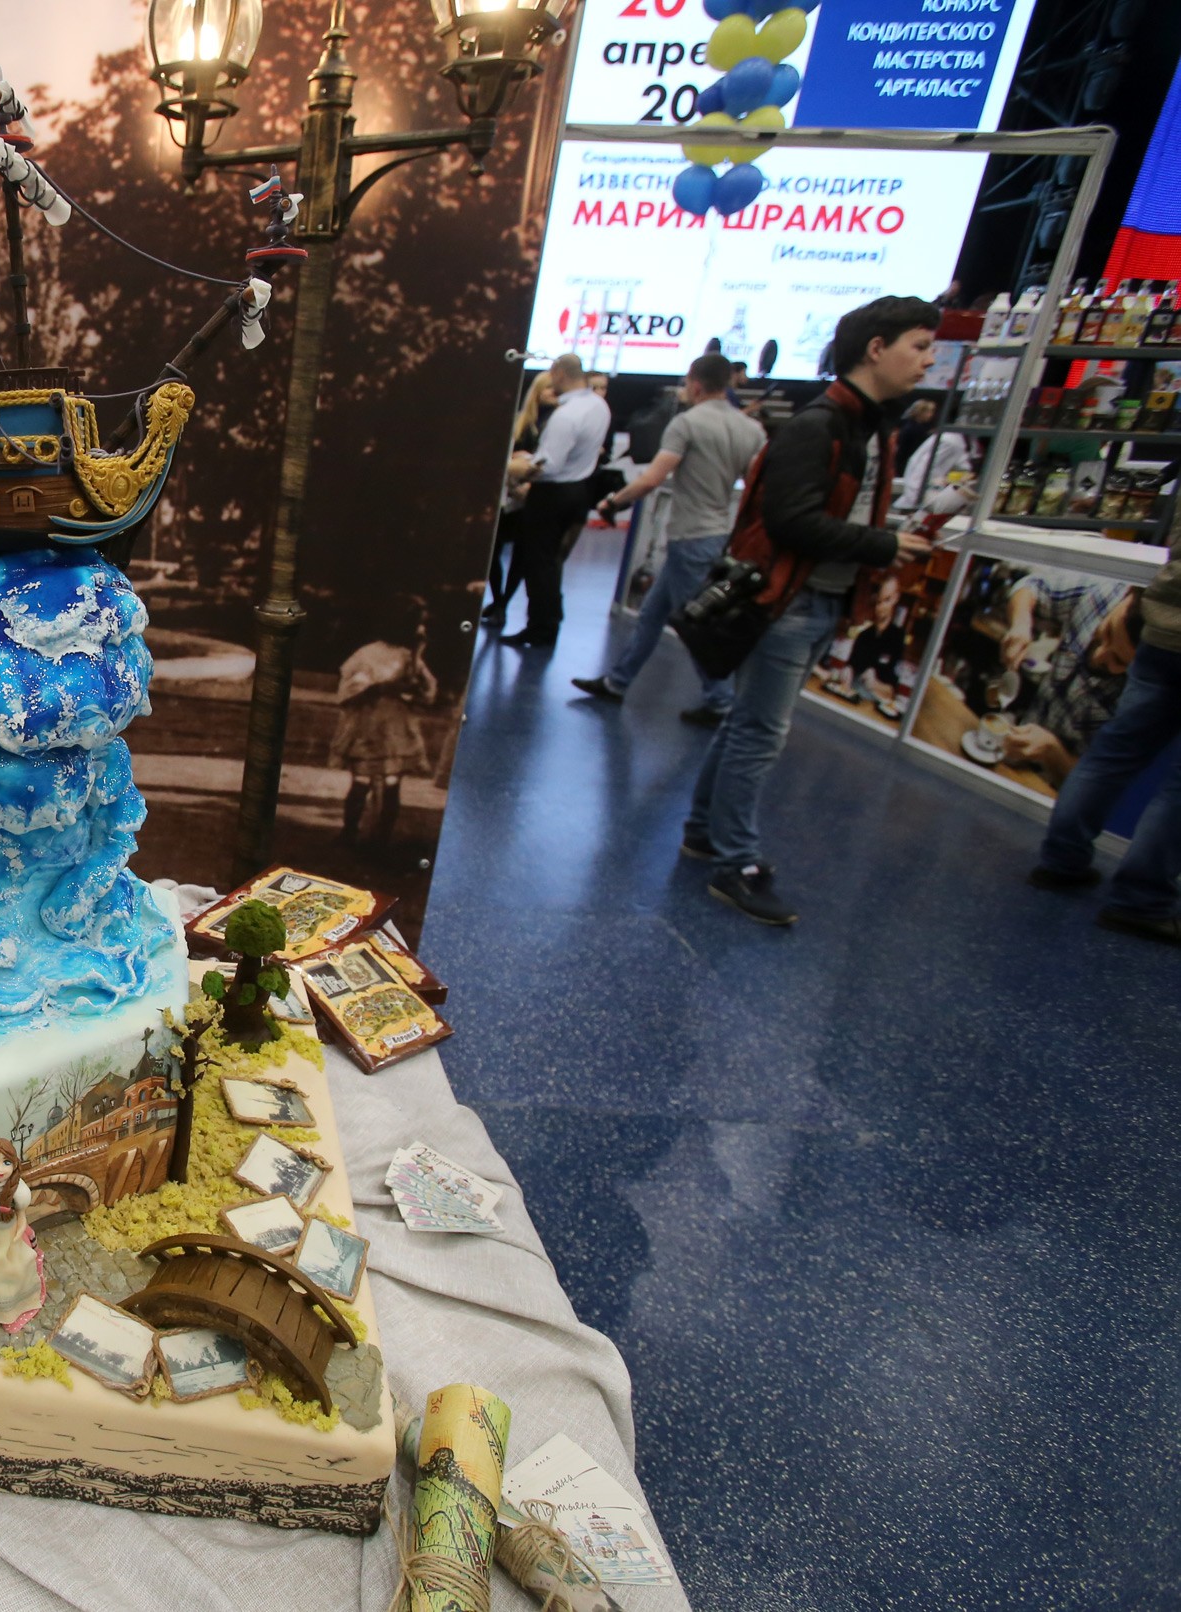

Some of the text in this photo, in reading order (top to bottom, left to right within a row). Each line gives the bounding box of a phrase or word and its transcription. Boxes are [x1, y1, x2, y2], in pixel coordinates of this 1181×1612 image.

[921, 0, 1003, 13] КОНКУРС
[846, 21, 997, 44] КОНДИТЕРСКОГО
[603, 41, 708, 77] апре
[872, 50, 987, 70] МАСТЕРСТВА
[639, 83, 699, 123] 20
[578, 173, 672, 191] ИЗВЕСТН
[722, 203, 905, 235] ШРАМКО
[601, 311, 685, 338] EXPO
